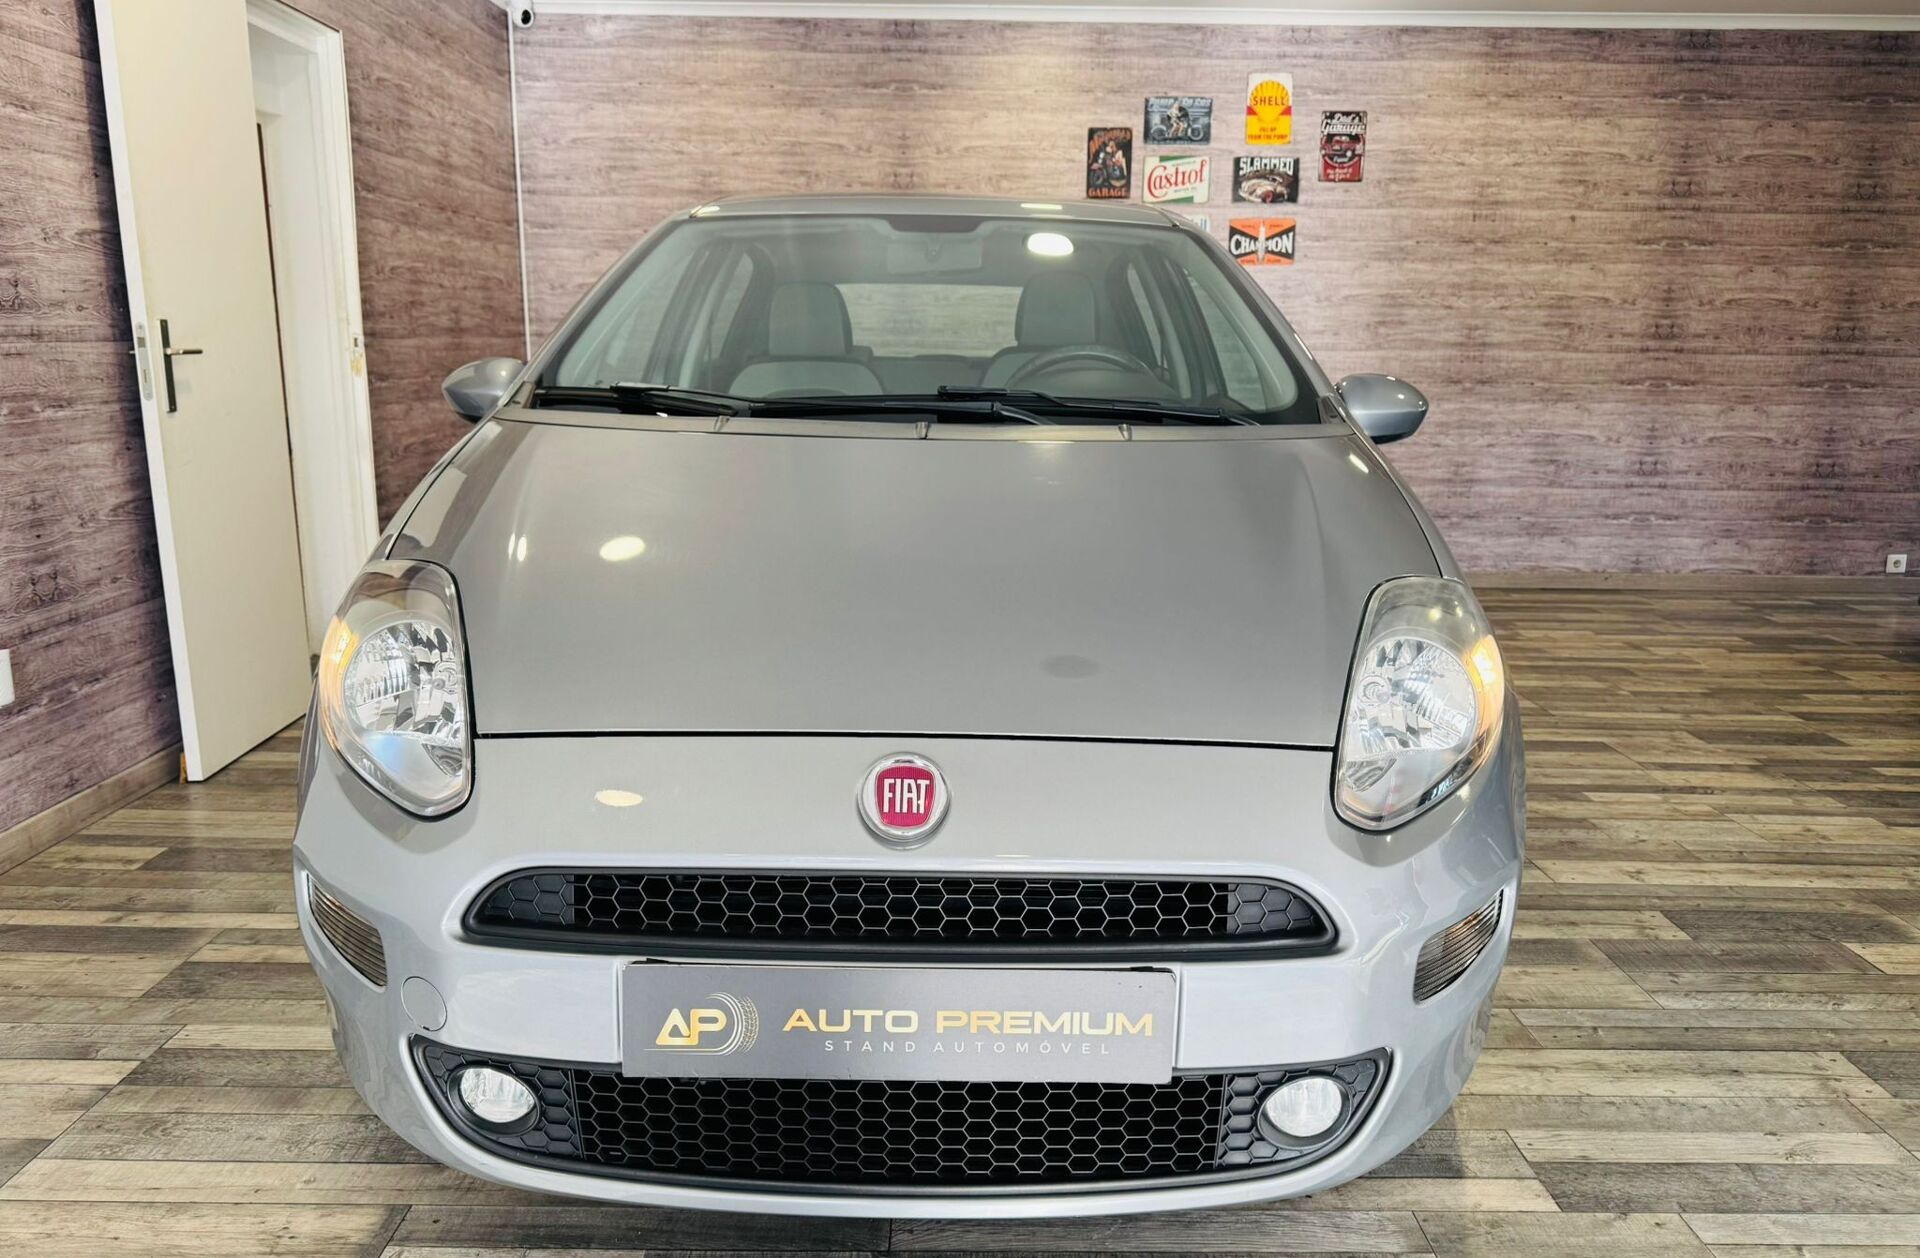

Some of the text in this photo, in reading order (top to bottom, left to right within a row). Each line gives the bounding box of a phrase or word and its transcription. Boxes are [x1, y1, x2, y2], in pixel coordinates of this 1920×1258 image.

[1252, 95, 1286, 106] SHELL
[1320, 119, 1366, 135] Garage
[1239, 157, 1294, 176] SLAMMED
[1088, 187, 1128, 198] GARAGE
[883, 778, 930, 814] FIAT
[655, 1007, 727, 1046] AP
[782, 1007, 1153, 1037] AUTO PREMIUM
[824, 1038, 1110, 1055] STAND AUTOMÓVEL
